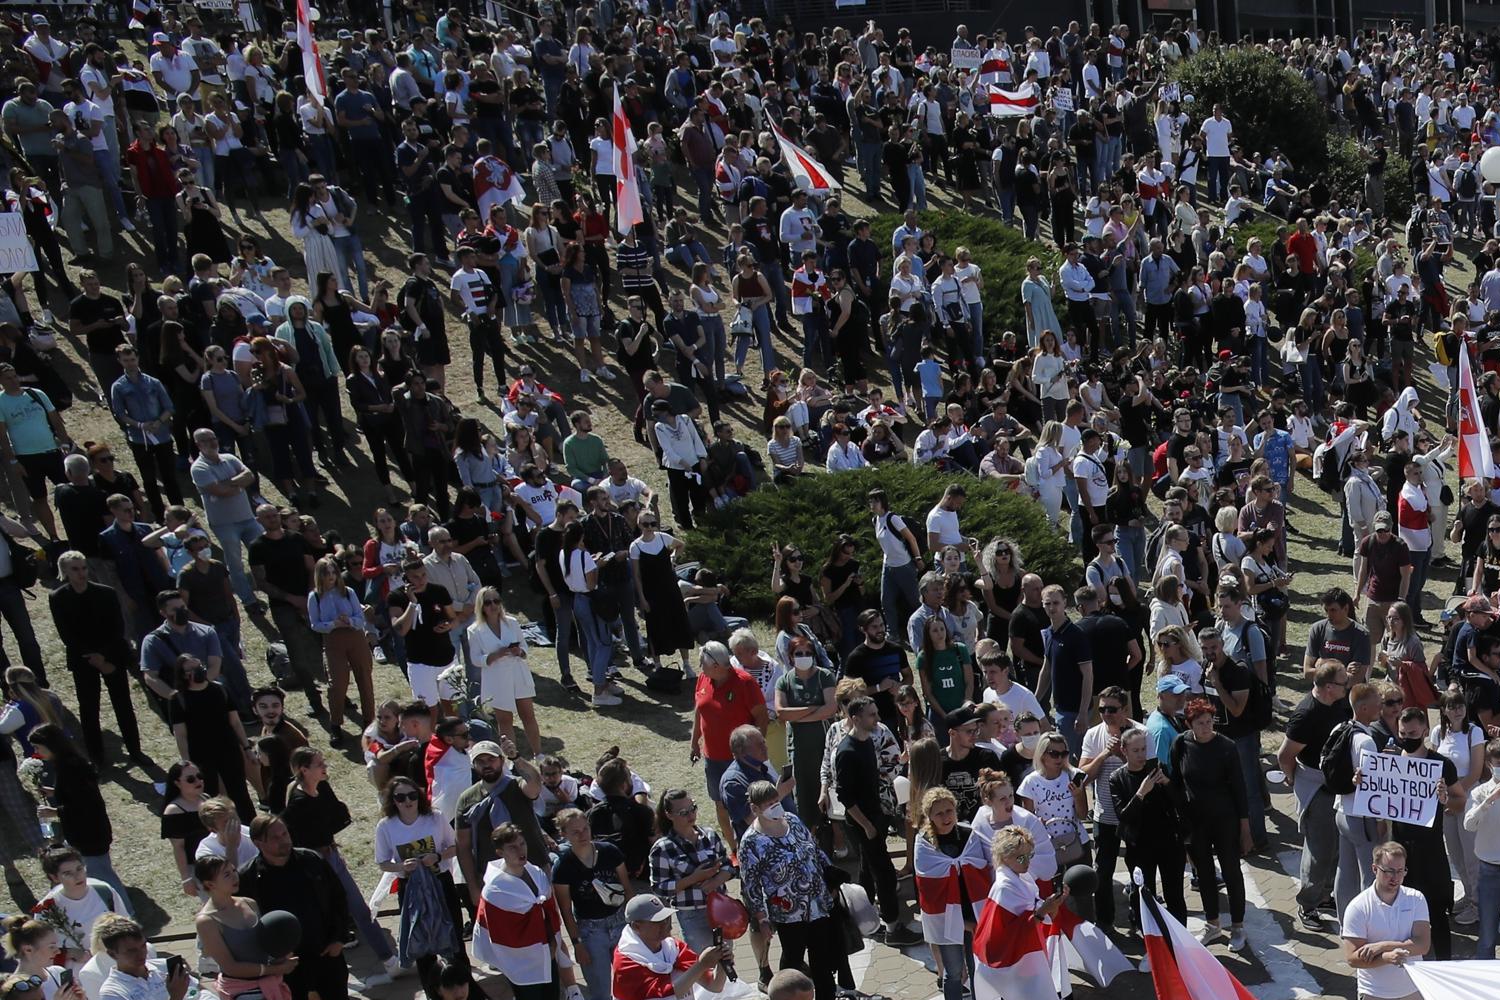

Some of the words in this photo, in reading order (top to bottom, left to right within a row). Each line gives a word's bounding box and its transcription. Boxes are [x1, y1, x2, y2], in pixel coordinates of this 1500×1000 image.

[1361, 753, 1401, 774] ГЭТА
[1407, 761, 1439, 779] МОГ
[1360, 775, 1399, 795] БЫЦЬ
[1400, 779, 1440, 799] ТВОЙ
[1367, 794, 1423, 821] СЫН
